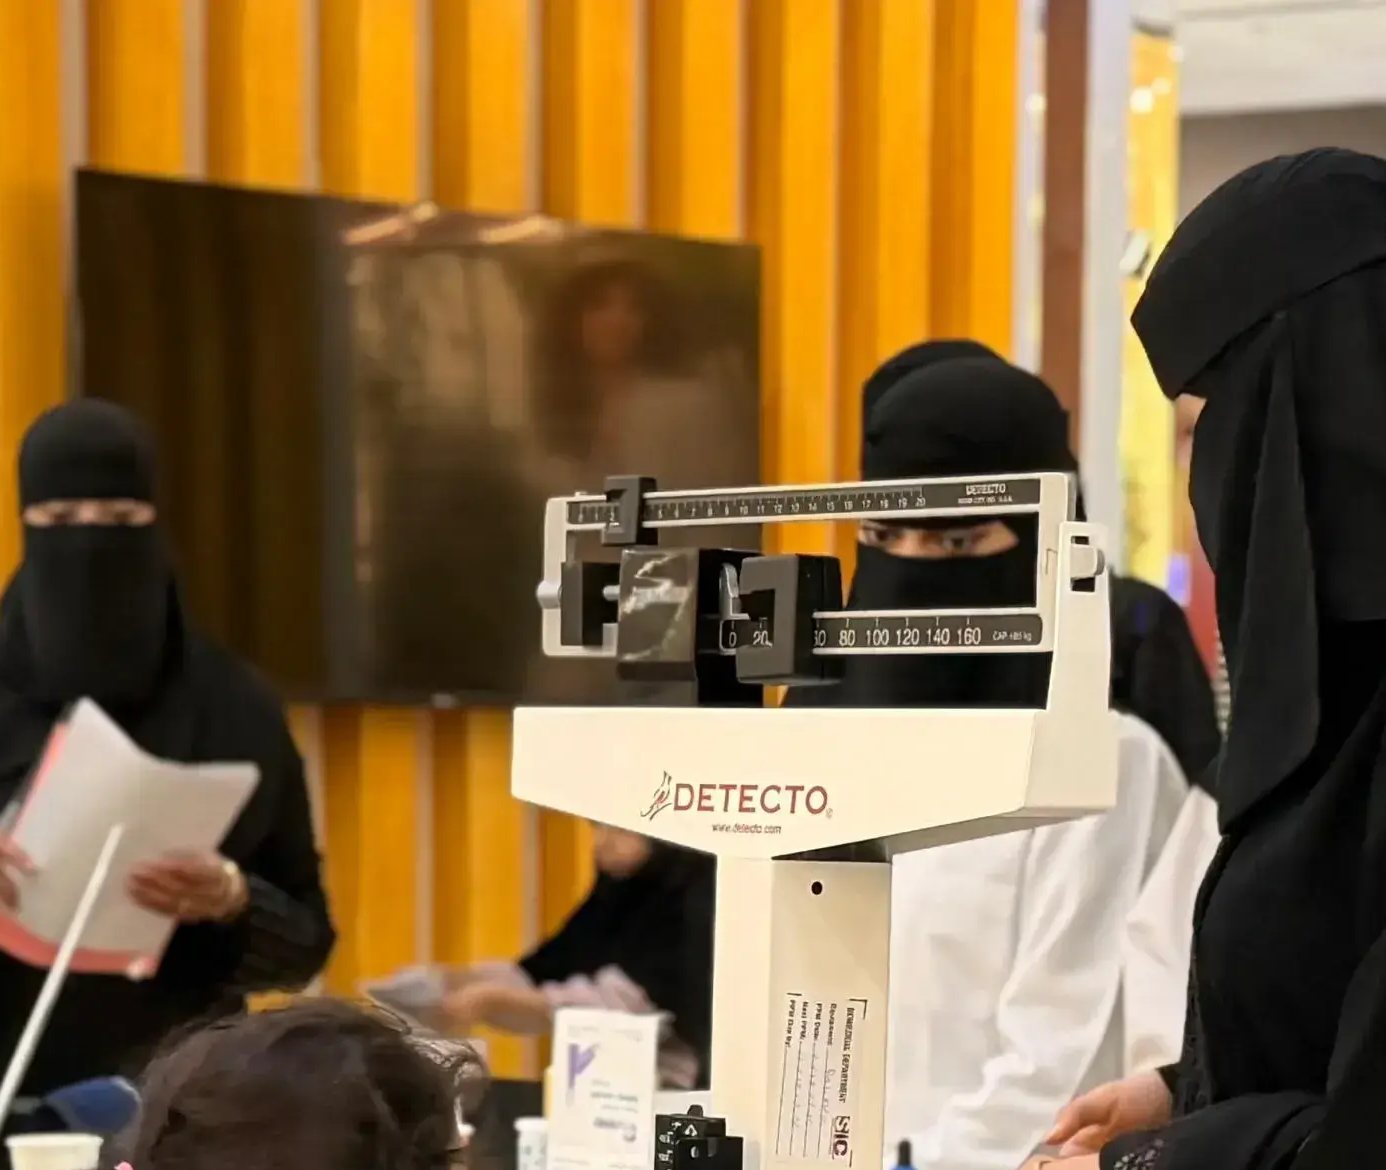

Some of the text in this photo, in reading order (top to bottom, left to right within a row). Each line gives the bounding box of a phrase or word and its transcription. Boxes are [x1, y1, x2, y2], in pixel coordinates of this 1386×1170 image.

[773, 504, 782, 513] 12
[862, 499, 871, 509] 17
[898, 498, 907, 508] 19
[915, 497, 925, 507] 20
[838, 629, 856, 646] 80
[866, 629, 889, 646] 100
[896, 629, 919, 646] 120
[926, 628, 950, 645] 140
[957, 627, 981, 645] 160
[673, 783, 828, 815] DETECTO
